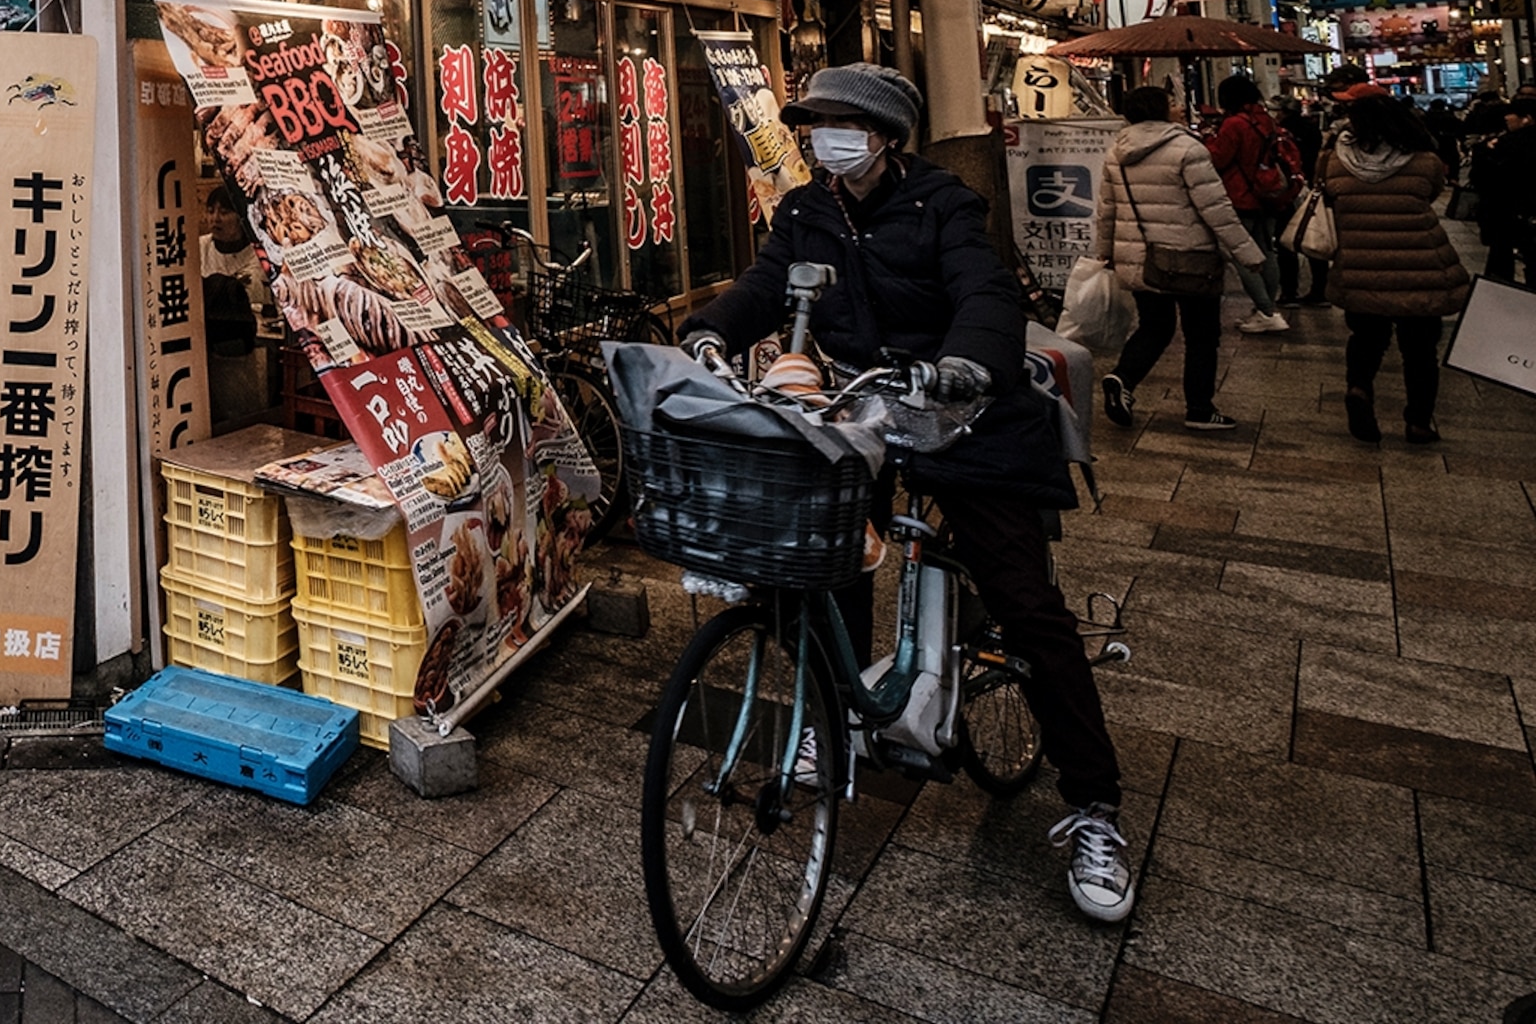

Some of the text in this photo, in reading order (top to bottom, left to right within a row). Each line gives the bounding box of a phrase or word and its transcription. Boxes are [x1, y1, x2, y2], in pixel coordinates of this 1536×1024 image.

[245, 33, 326, 81] Seafood
[261, 71, 358, 144] BBQ
[1019, 64, 1058, 118] らー
[440, 43, 480, 207] 刺身
[484, 48, 523, 200] 浜焼
[643, 57, 675, 245] 海鮮丼
[1022, 222, 1091, 241] 支付宝
[1026, 242, 1091, 252] ALIPAY
[1507, 352, 1536, 369] GU
